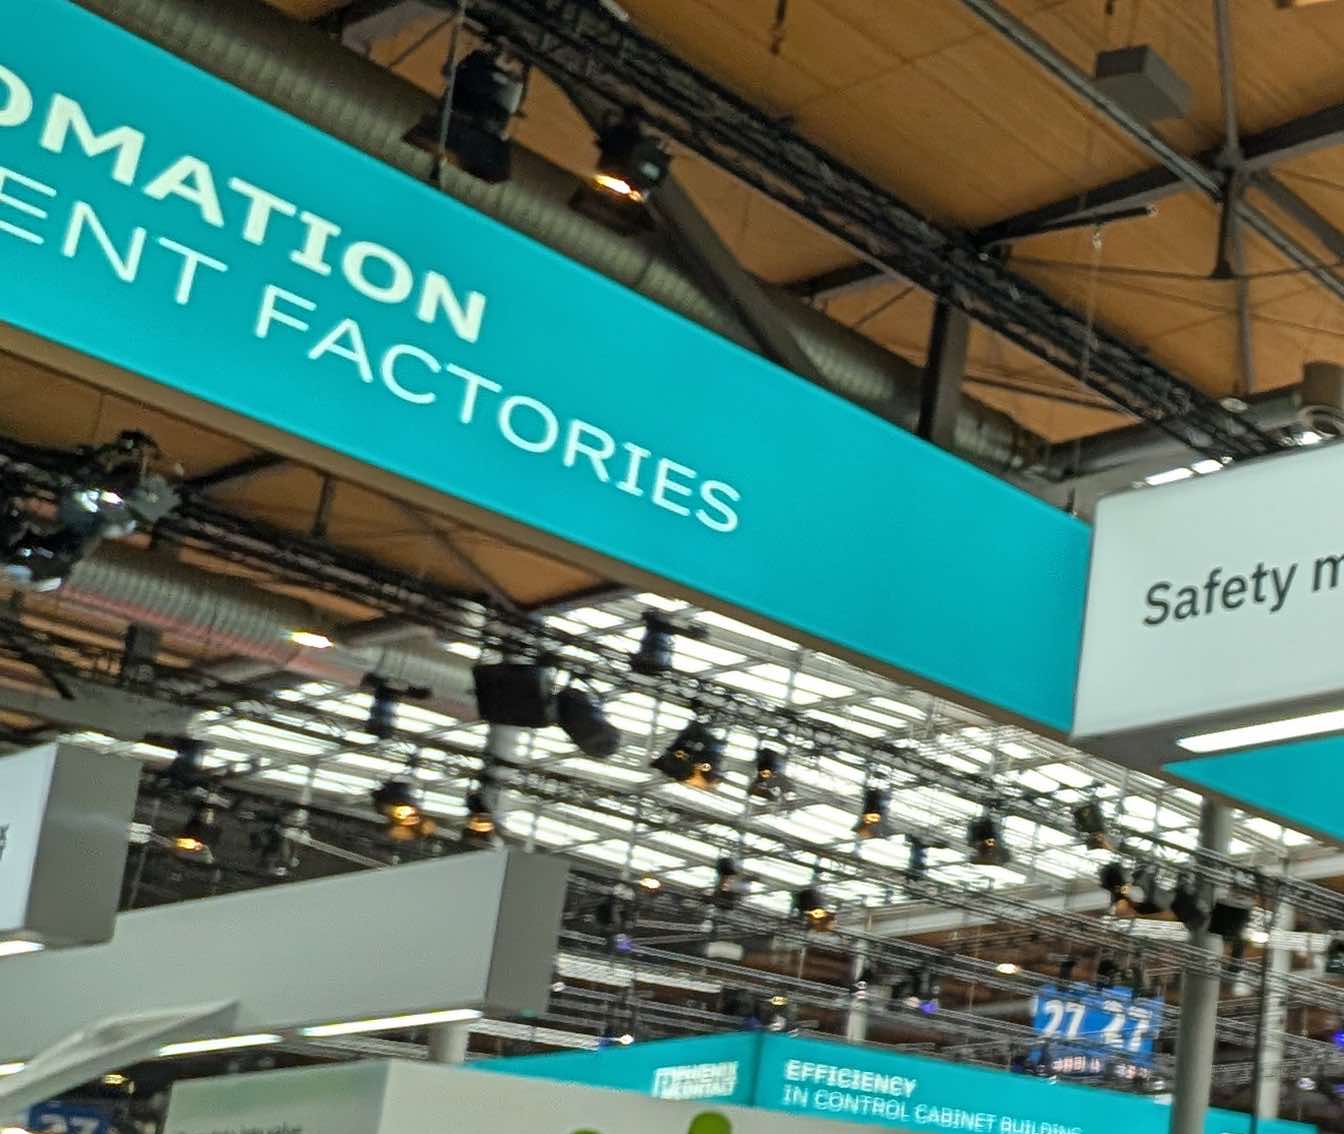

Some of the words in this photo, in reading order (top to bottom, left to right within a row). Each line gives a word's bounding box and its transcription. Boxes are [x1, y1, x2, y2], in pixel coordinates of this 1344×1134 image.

[253, 283, 744, 534] FACTORIES
[1142, 562, 1297, 626] Safety
[784, 1059, 918, 1096] EFFICIENCY
[783, 1085, 808, 1107] IN
[814, 1090, 909, 1123] CONTROL
[915, 1102, 997, 1134] CABINET
